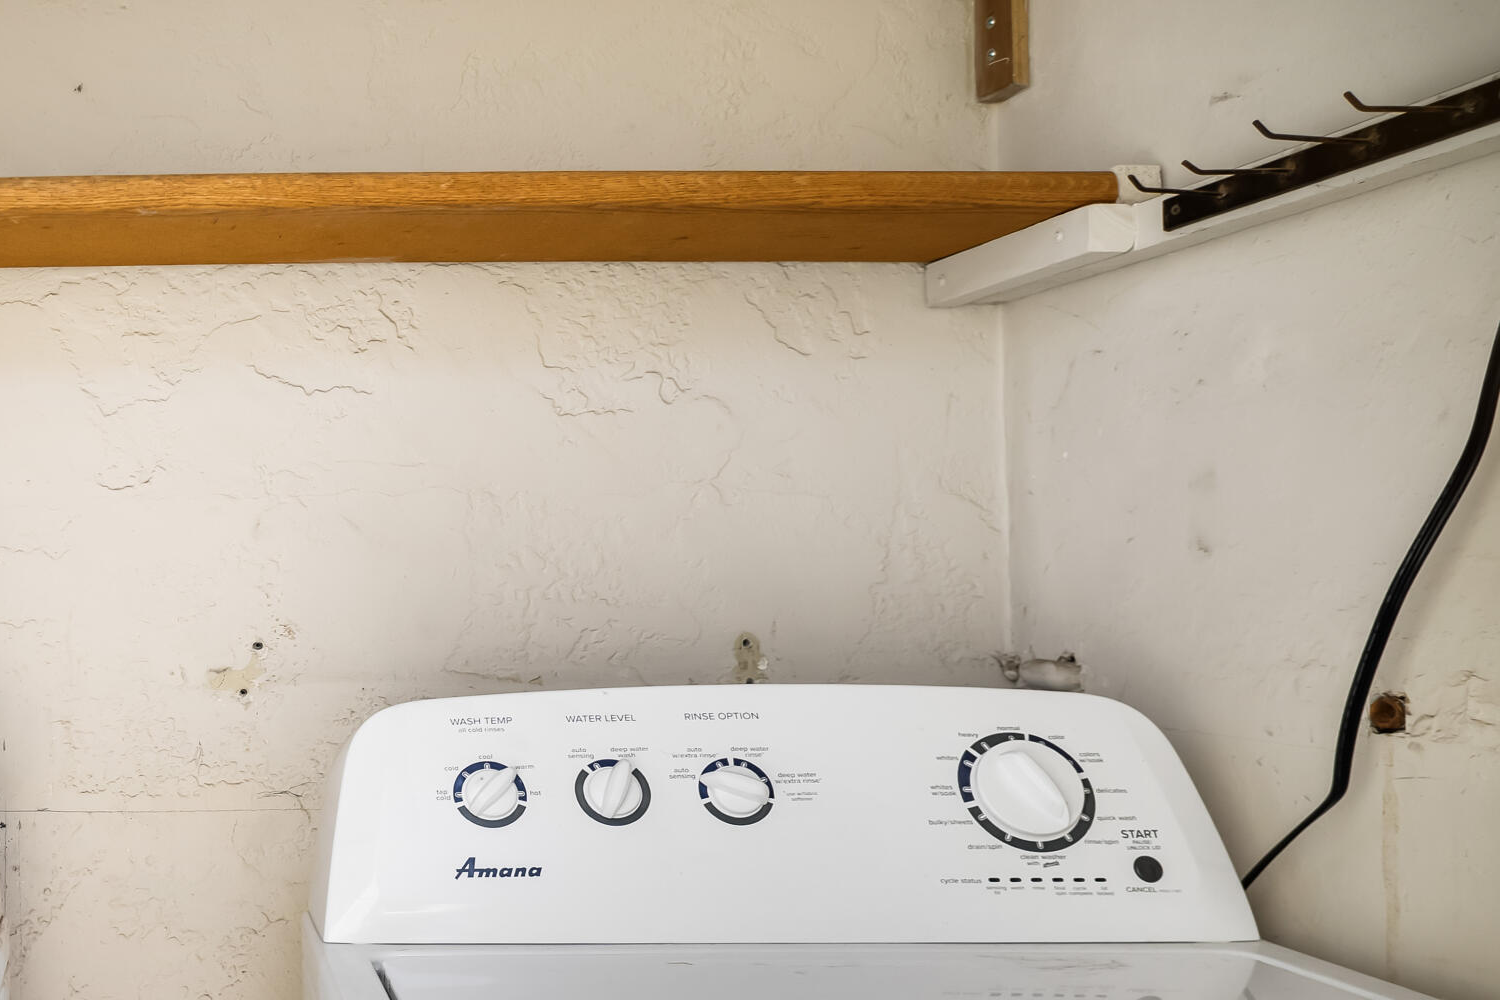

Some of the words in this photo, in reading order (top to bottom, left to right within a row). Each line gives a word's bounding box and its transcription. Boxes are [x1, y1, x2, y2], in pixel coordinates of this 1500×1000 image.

[718, 712, 760, 720] OPTION
[1121, 830, 1158, 838] START
[454, 857, 542, 880] Amana
